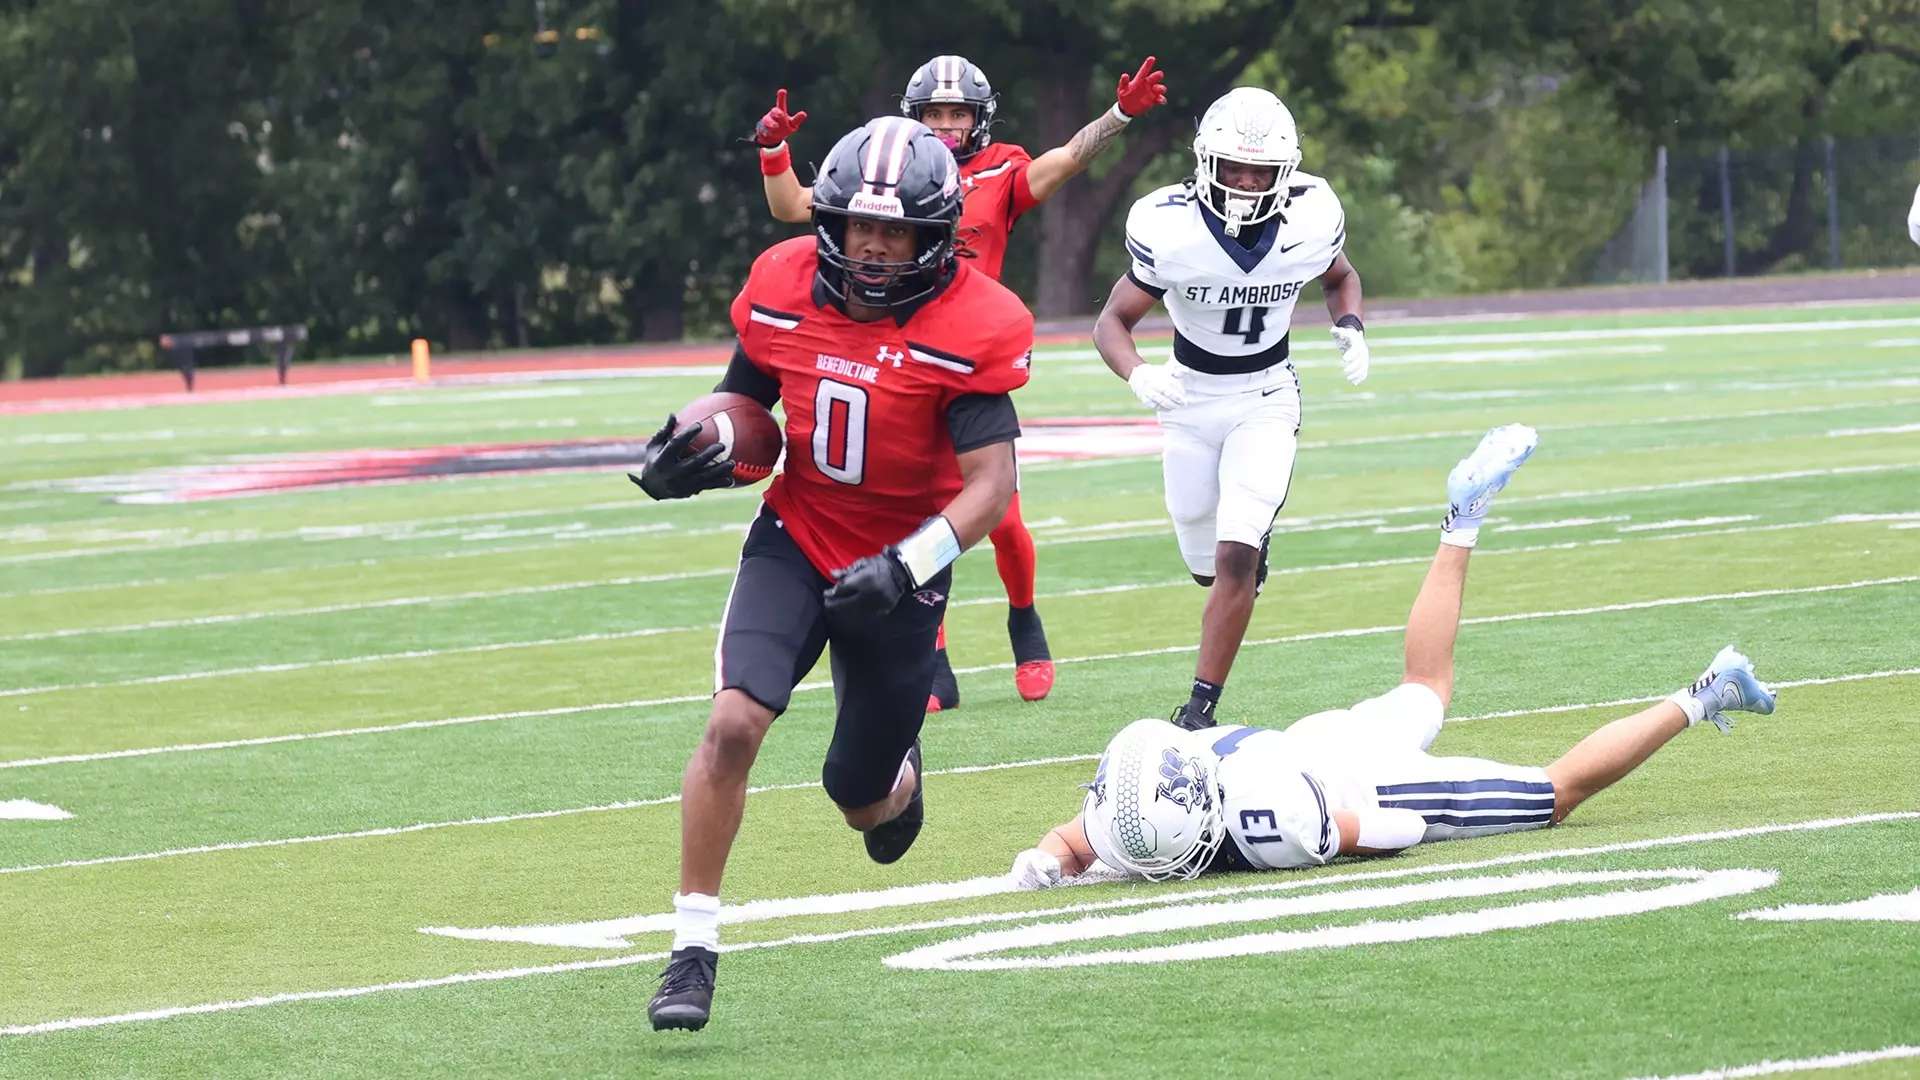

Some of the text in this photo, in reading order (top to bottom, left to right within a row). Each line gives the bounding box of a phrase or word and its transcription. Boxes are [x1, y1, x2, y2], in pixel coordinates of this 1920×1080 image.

[854, 199, 898, 213] Riddell
[1186, 281, 1303, 304] ST. AMBROSE
[1222, 307, 1269, 345] 4
[816, 353, 880, 384] BENEDICTINE
[812, 377, 869, 486] 0
[1239, 809, 1282, 844] 13
